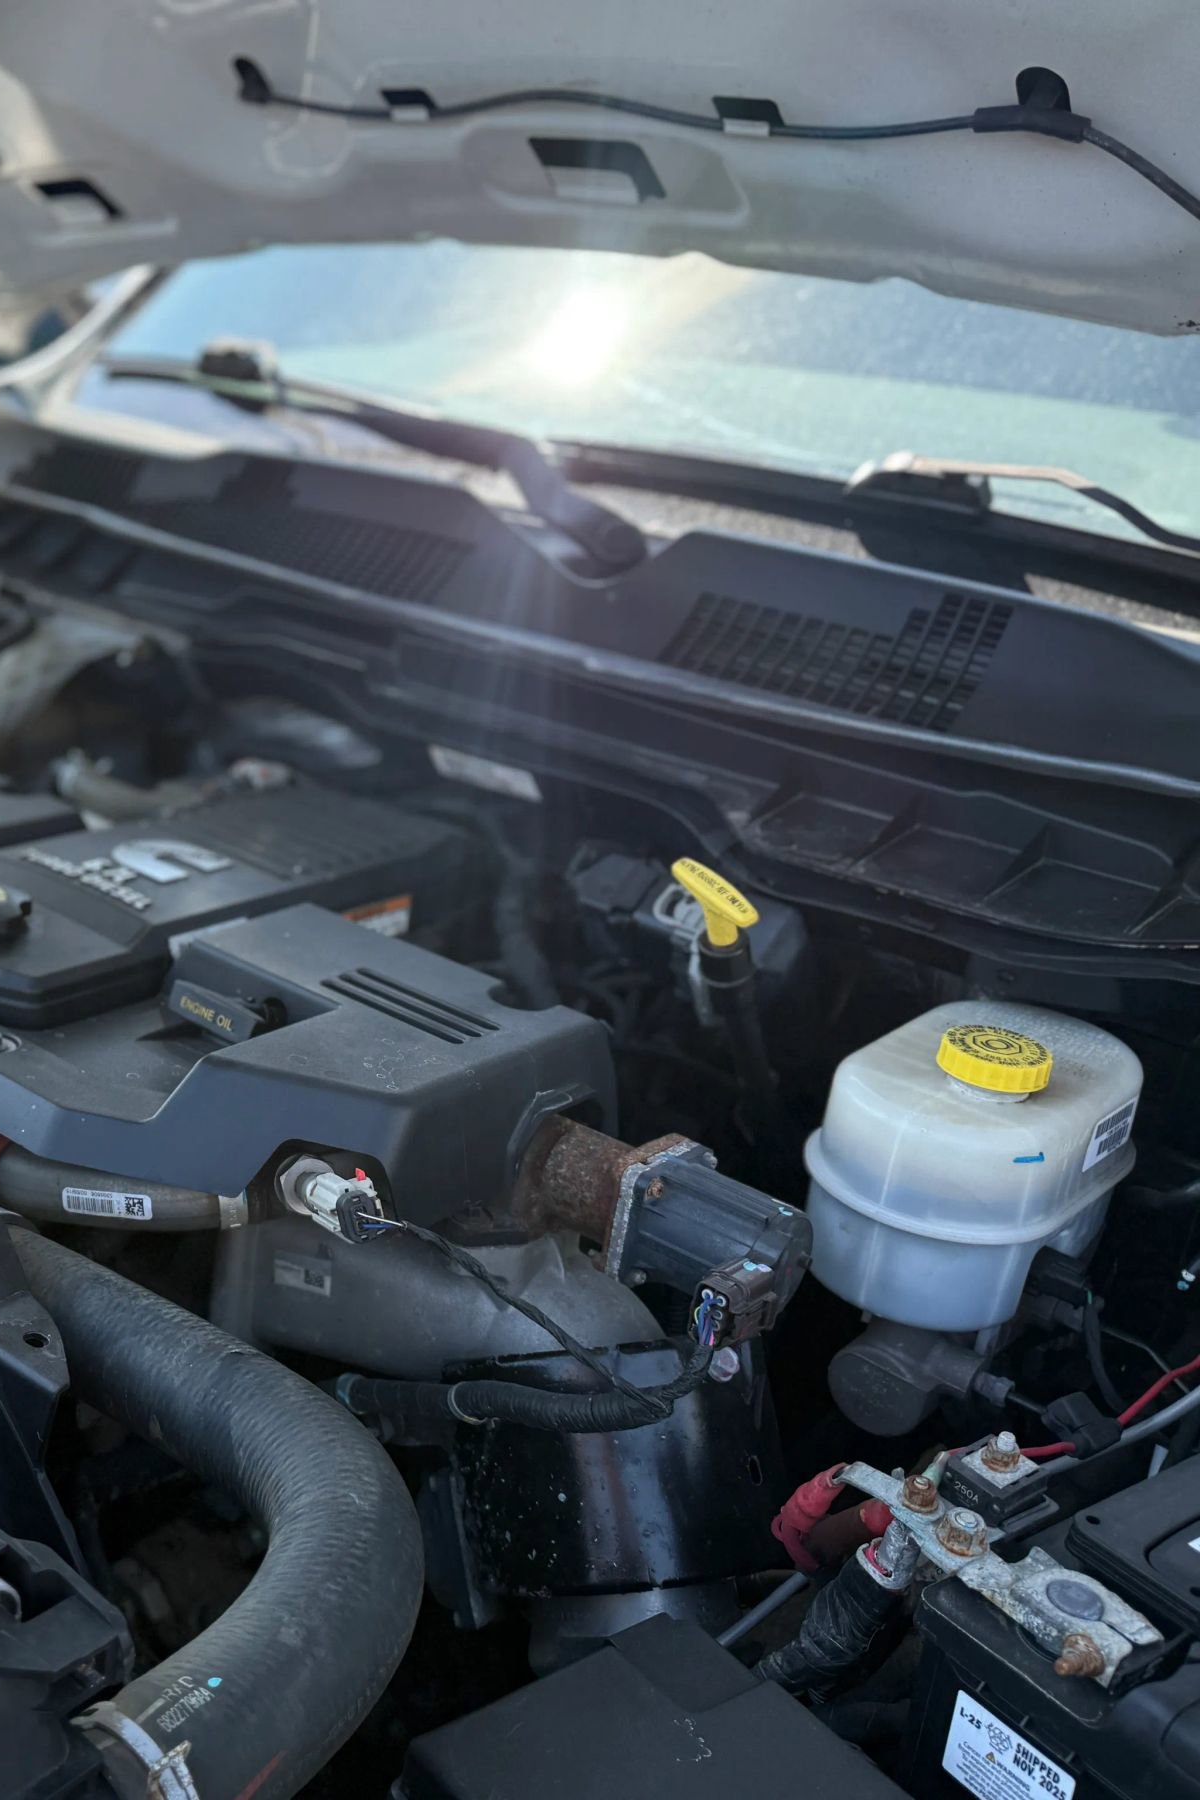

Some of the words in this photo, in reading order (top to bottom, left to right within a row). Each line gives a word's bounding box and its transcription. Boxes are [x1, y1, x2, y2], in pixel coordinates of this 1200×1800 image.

[180, 996, 216, 1022] ENGINE
[216, 1014, 233, 1033] OIL
[953, 1480, 979, 1505] 250A
[960, 1706, 982, 1730] L-25
[1012, 1753, 1036, 1781] NOV.
[1038, 1775, 1067, 1800] 2025
[1015, 1743, 1060, 1785] SHIPPED
